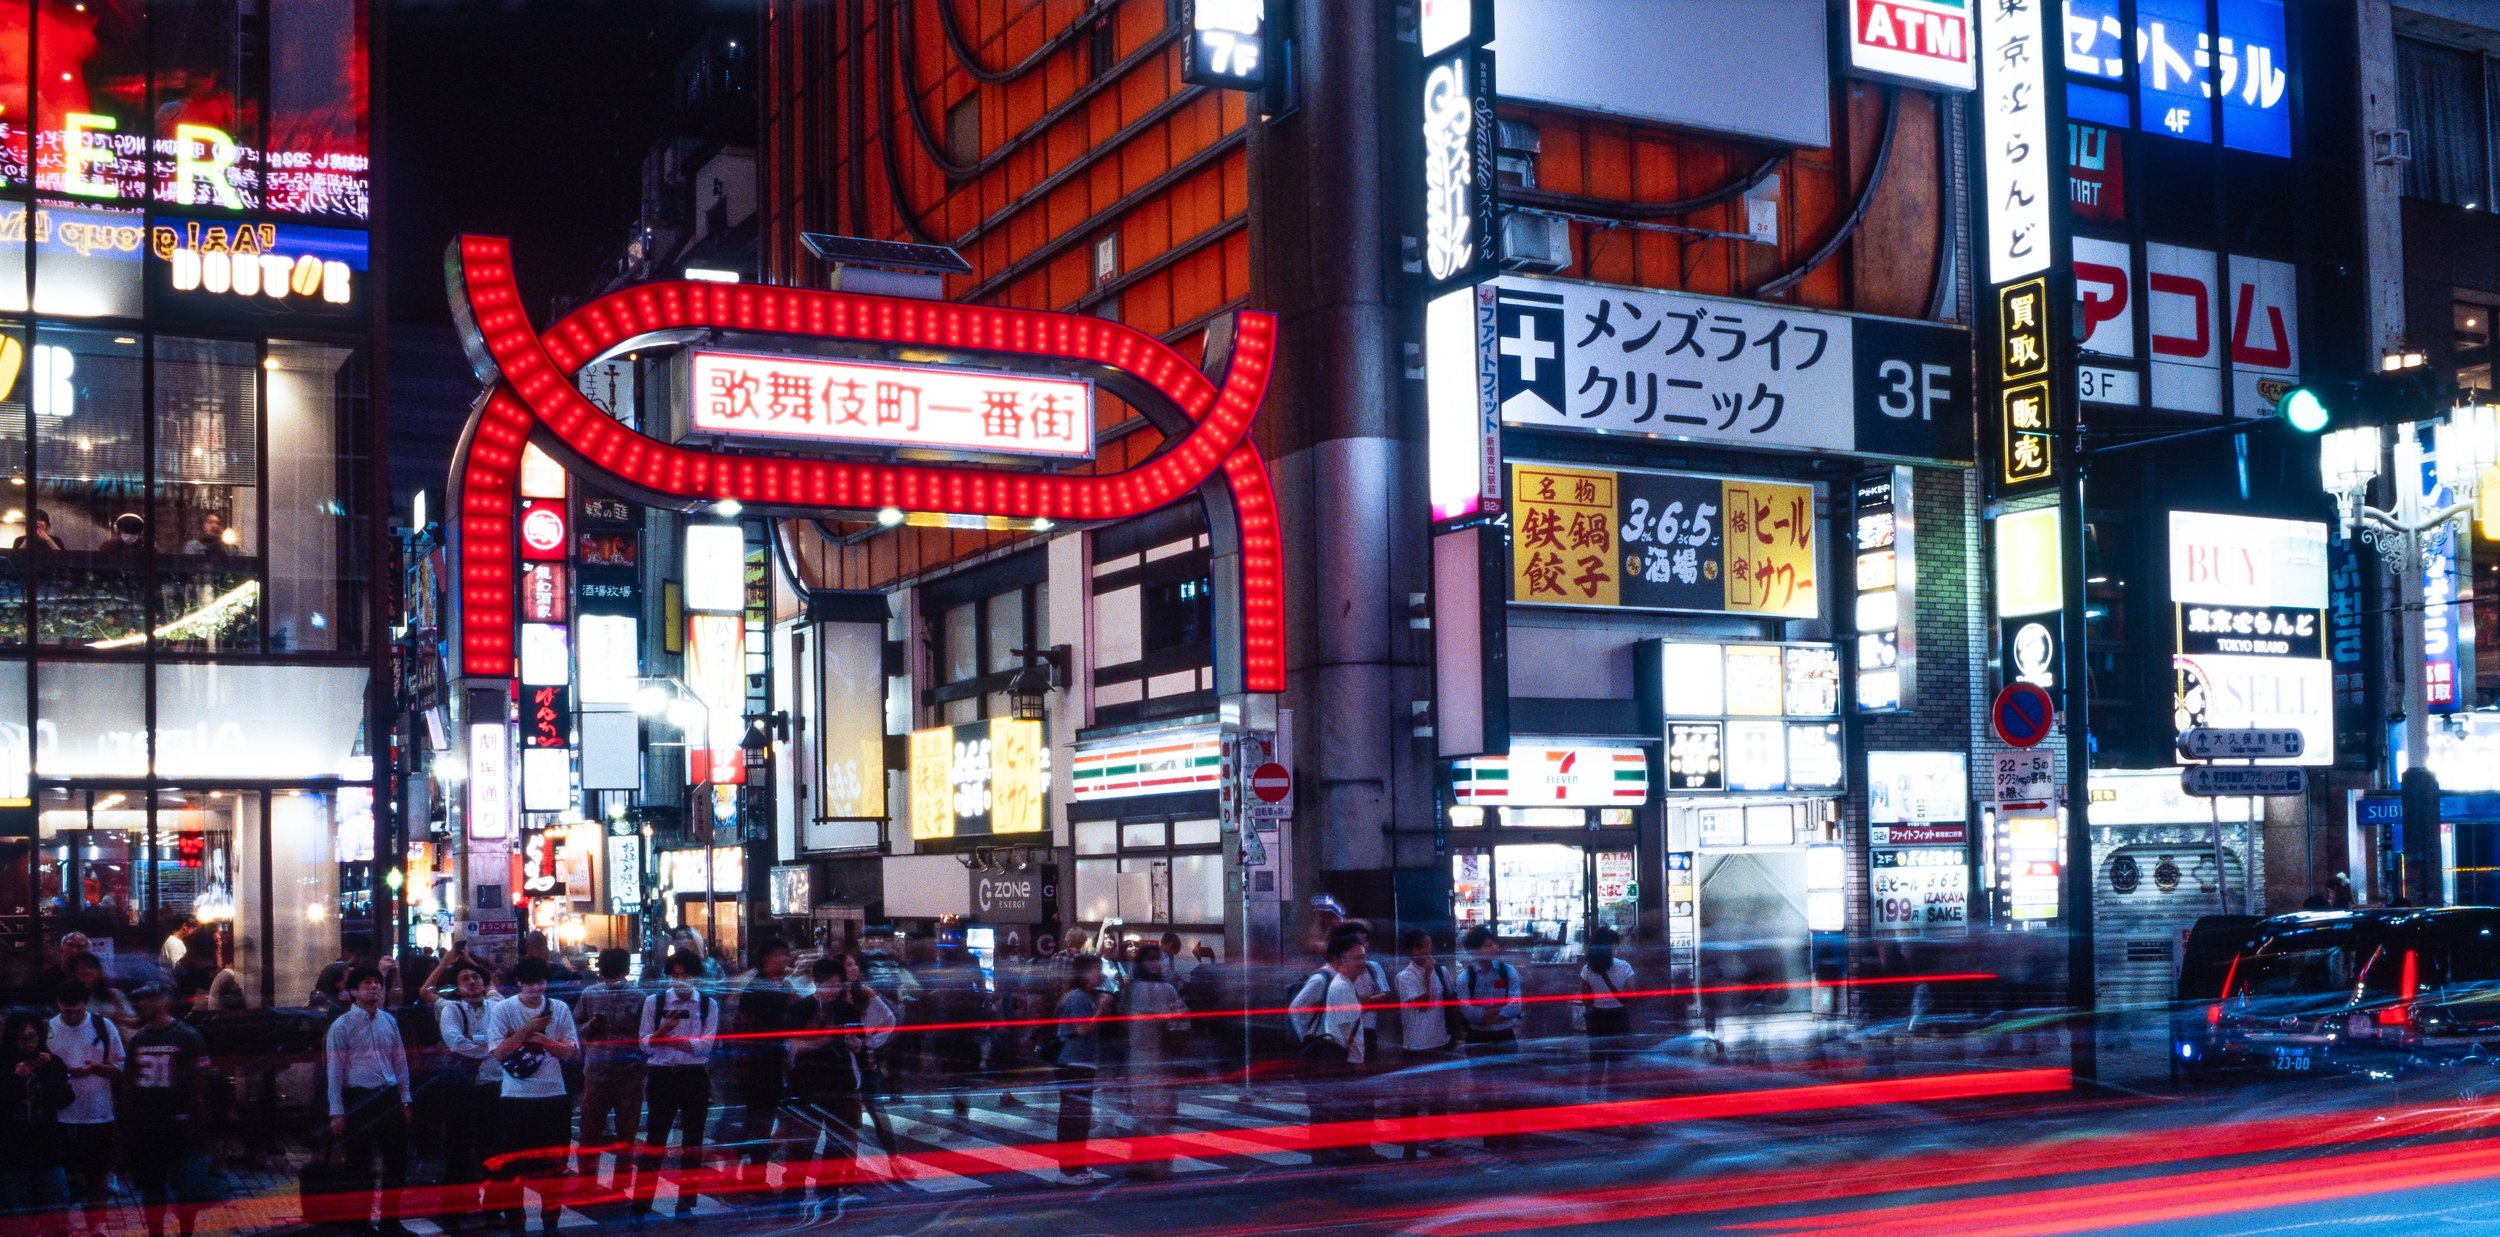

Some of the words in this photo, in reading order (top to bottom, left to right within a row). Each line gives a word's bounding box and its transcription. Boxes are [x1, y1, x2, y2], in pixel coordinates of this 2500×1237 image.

[1865, 3, 1962, 59] ATM
[1203, 32, 1258, 77] 7F
[2165, 108, 2190, 133] 4F
[1474, 97, 1495, 191] Sparkle
[1479, 194, 1495, 260] スパークル
[172, 248, 351, 304] DOUTOR
[1577, 299, 1830, 371] メンズライフ
[2010, 293, 2036, 368] 買取
[2072, 260, 2292, 369] アコム
[1481, 305, 1499, 434] ファイトフィット
[1878, 358, 1952, 422] 3F
[2081, 370, 2115, 398] 3F
[709, 366, 1075, 443] 歌舞伎町一番街
[1578, 365, 1784, 434] クリニック
[2011, 396, 2042, 472] 販売
[1486, 436, 1497, 495] 新宿東口駅前
[1484, 501, 1499, 511] B2F
[1537, 476, 1597, 503] 名物
[1521, 507, 1609, 554] 鉄鍋
[1753, 494, 1812, 548] ビール
[1645, 546, 1699, 585] 酒場
[1731, 509, 1748, 582] 格安
[2187, 543, 2262, 587] BUY
[582, 584, 632, 598] 酒場牧場
[1521, 552, 1611, 598] 餃子
[1754, 557, 1814, 611] サワー
[2217, 638, 2252, 653] TOKYO
[2253, 640, 2289, 654] BRAND
[2224, 671, 2319, 716] SELL
[2214, 733, 2281, 745] 大久保病院
[480, 733, 498, 828] 劇場通り
[1254, 806, 1289, 818] 自転車を除く
[1891, 829, 1935, 840] ファイトフィット
[1601, 851, 1632, 860] ATM
[1877, 854, 1893, 864] 2F
[999, 901, 1025, 909] ENERGY
[1597, 883, 1622, 898] たばこ
[1625, 883, 1638, 898] 酒
[1875, 897, 1912, 923] 199
[1924, 891, 1966, 904] IZAKAYA
[1926, 906, 1963, 921] SAKE
